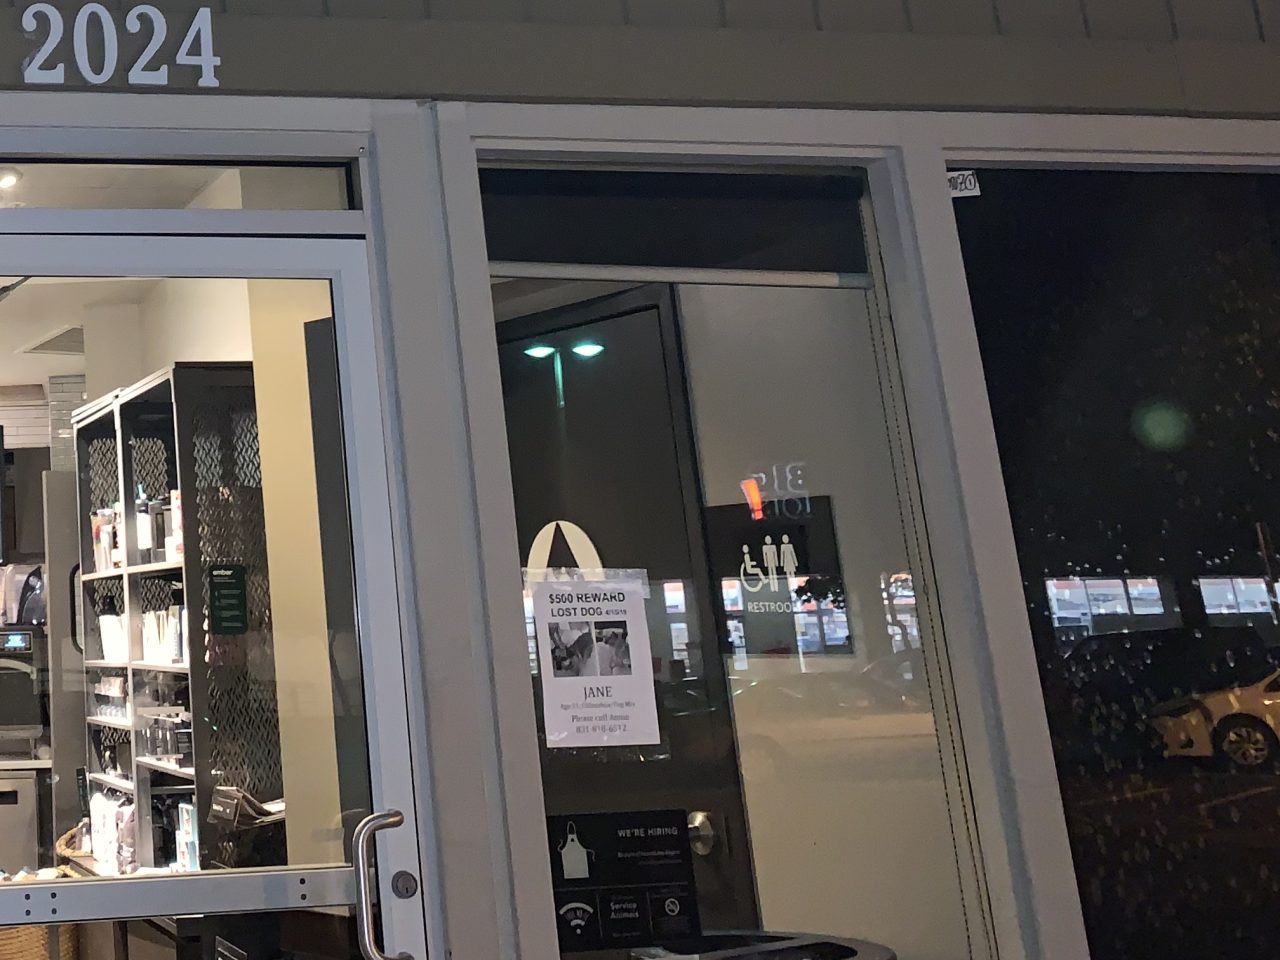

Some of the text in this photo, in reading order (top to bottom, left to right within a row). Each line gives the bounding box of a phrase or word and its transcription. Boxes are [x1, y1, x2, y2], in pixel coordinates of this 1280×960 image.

[21, 2, 222, 88] 2024
[549, 592, 626, 604] $500 REWARD
[551, 607, 577, 617] LOST
[580, 607, 603, 617] DOG
[747, 601, 792, 613] RESTROO
[584, 686, 613, 701] JANE
[647, 827, 678, 837] HIRING
[610, 902, 637, 911] Service
[610, 911, 639, 920] Animals
